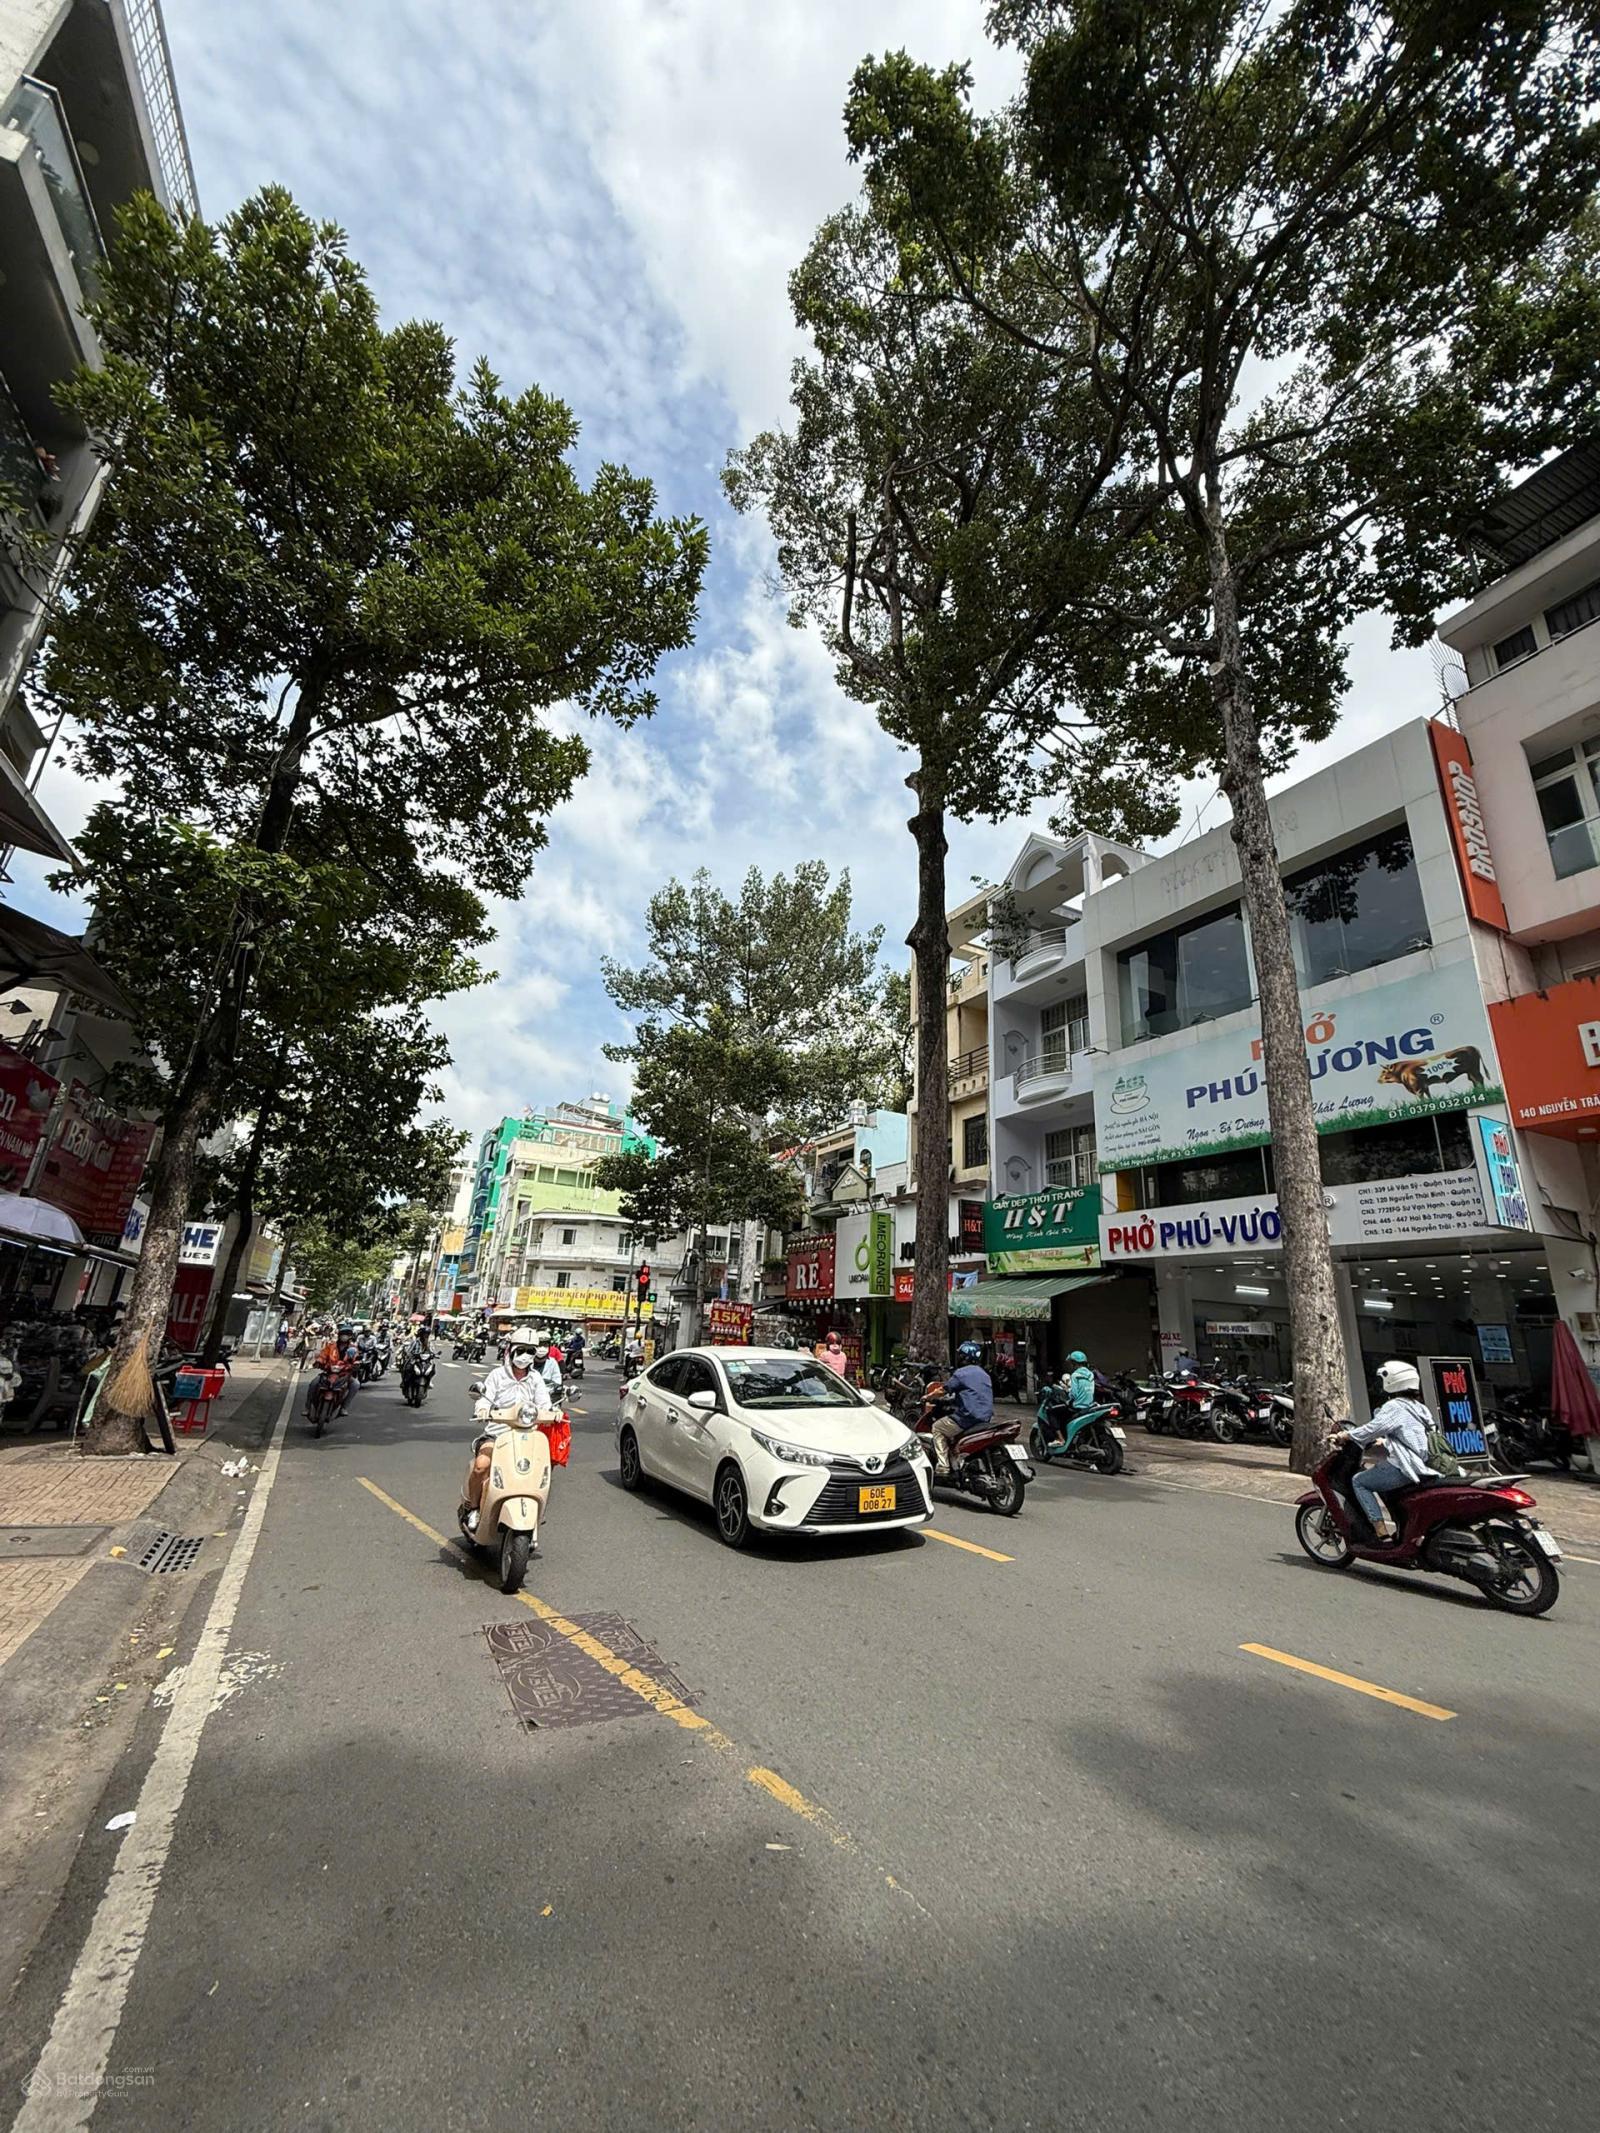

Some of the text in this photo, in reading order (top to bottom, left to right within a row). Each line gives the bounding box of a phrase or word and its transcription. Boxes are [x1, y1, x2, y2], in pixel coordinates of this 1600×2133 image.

[1185, 1027, 1435, 1109] PHÚ-ƯƠNG
[1427, 1061, 1453, 1075] 100%
[1409, 1093, 1486, 1115] 0379.032.014
[1519, 1108, 1537, 1119] 140
[1538, 1097, 1578, 1115] NGUYỄN
[1186, 1128, 1208, 1141] Ngon
[1051, 1189, 1084, 1202] TRANG
[184, 1227, 218, 1248] HE
[1108, 1213, 1155, 1254] PHỞ
[1159, 1206, 1283, 1249] PHÚ-VƯƠ
[182, 1251, 211, 1259] UES
[875, 1213, 887, 1293] LIMEORANGE
[900, 1283, 914, 1295] SAL
[168, 1293, 205, 1323] ALE
[712, 1310, 742, 1324] 15K
[1442, 1364, 1467, 1394] PHỞ
[1448, 1395, 1472, 1424] PHÚ
[870, 1488, 885, 1499] 60E
